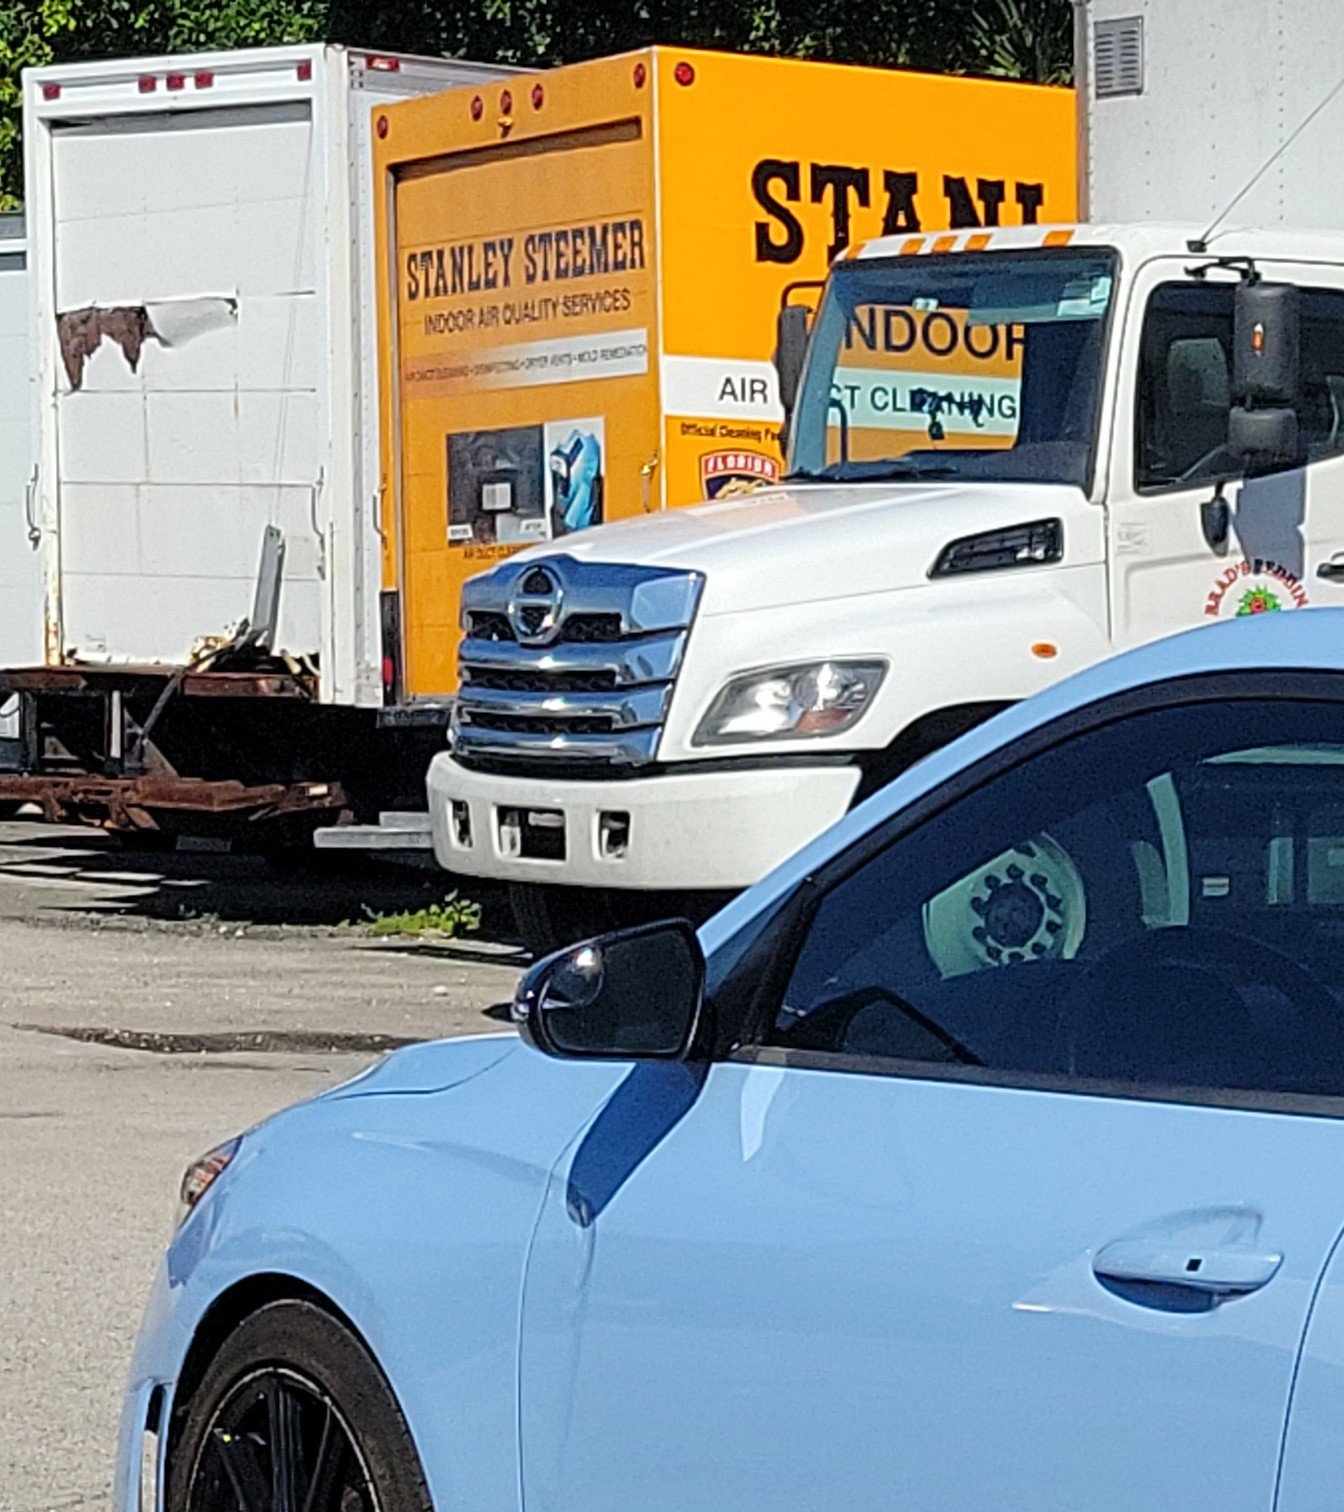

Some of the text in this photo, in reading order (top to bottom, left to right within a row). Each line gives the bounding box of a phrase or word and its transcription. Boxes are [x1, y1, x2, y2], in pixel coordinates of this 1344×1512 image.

[407, 219, 645, 300] STANLEY STEEMER
[424, 288, 632, 335] INDOOR AIR QUALITY SERVICES
[718, 376, 769, 404] AIR
